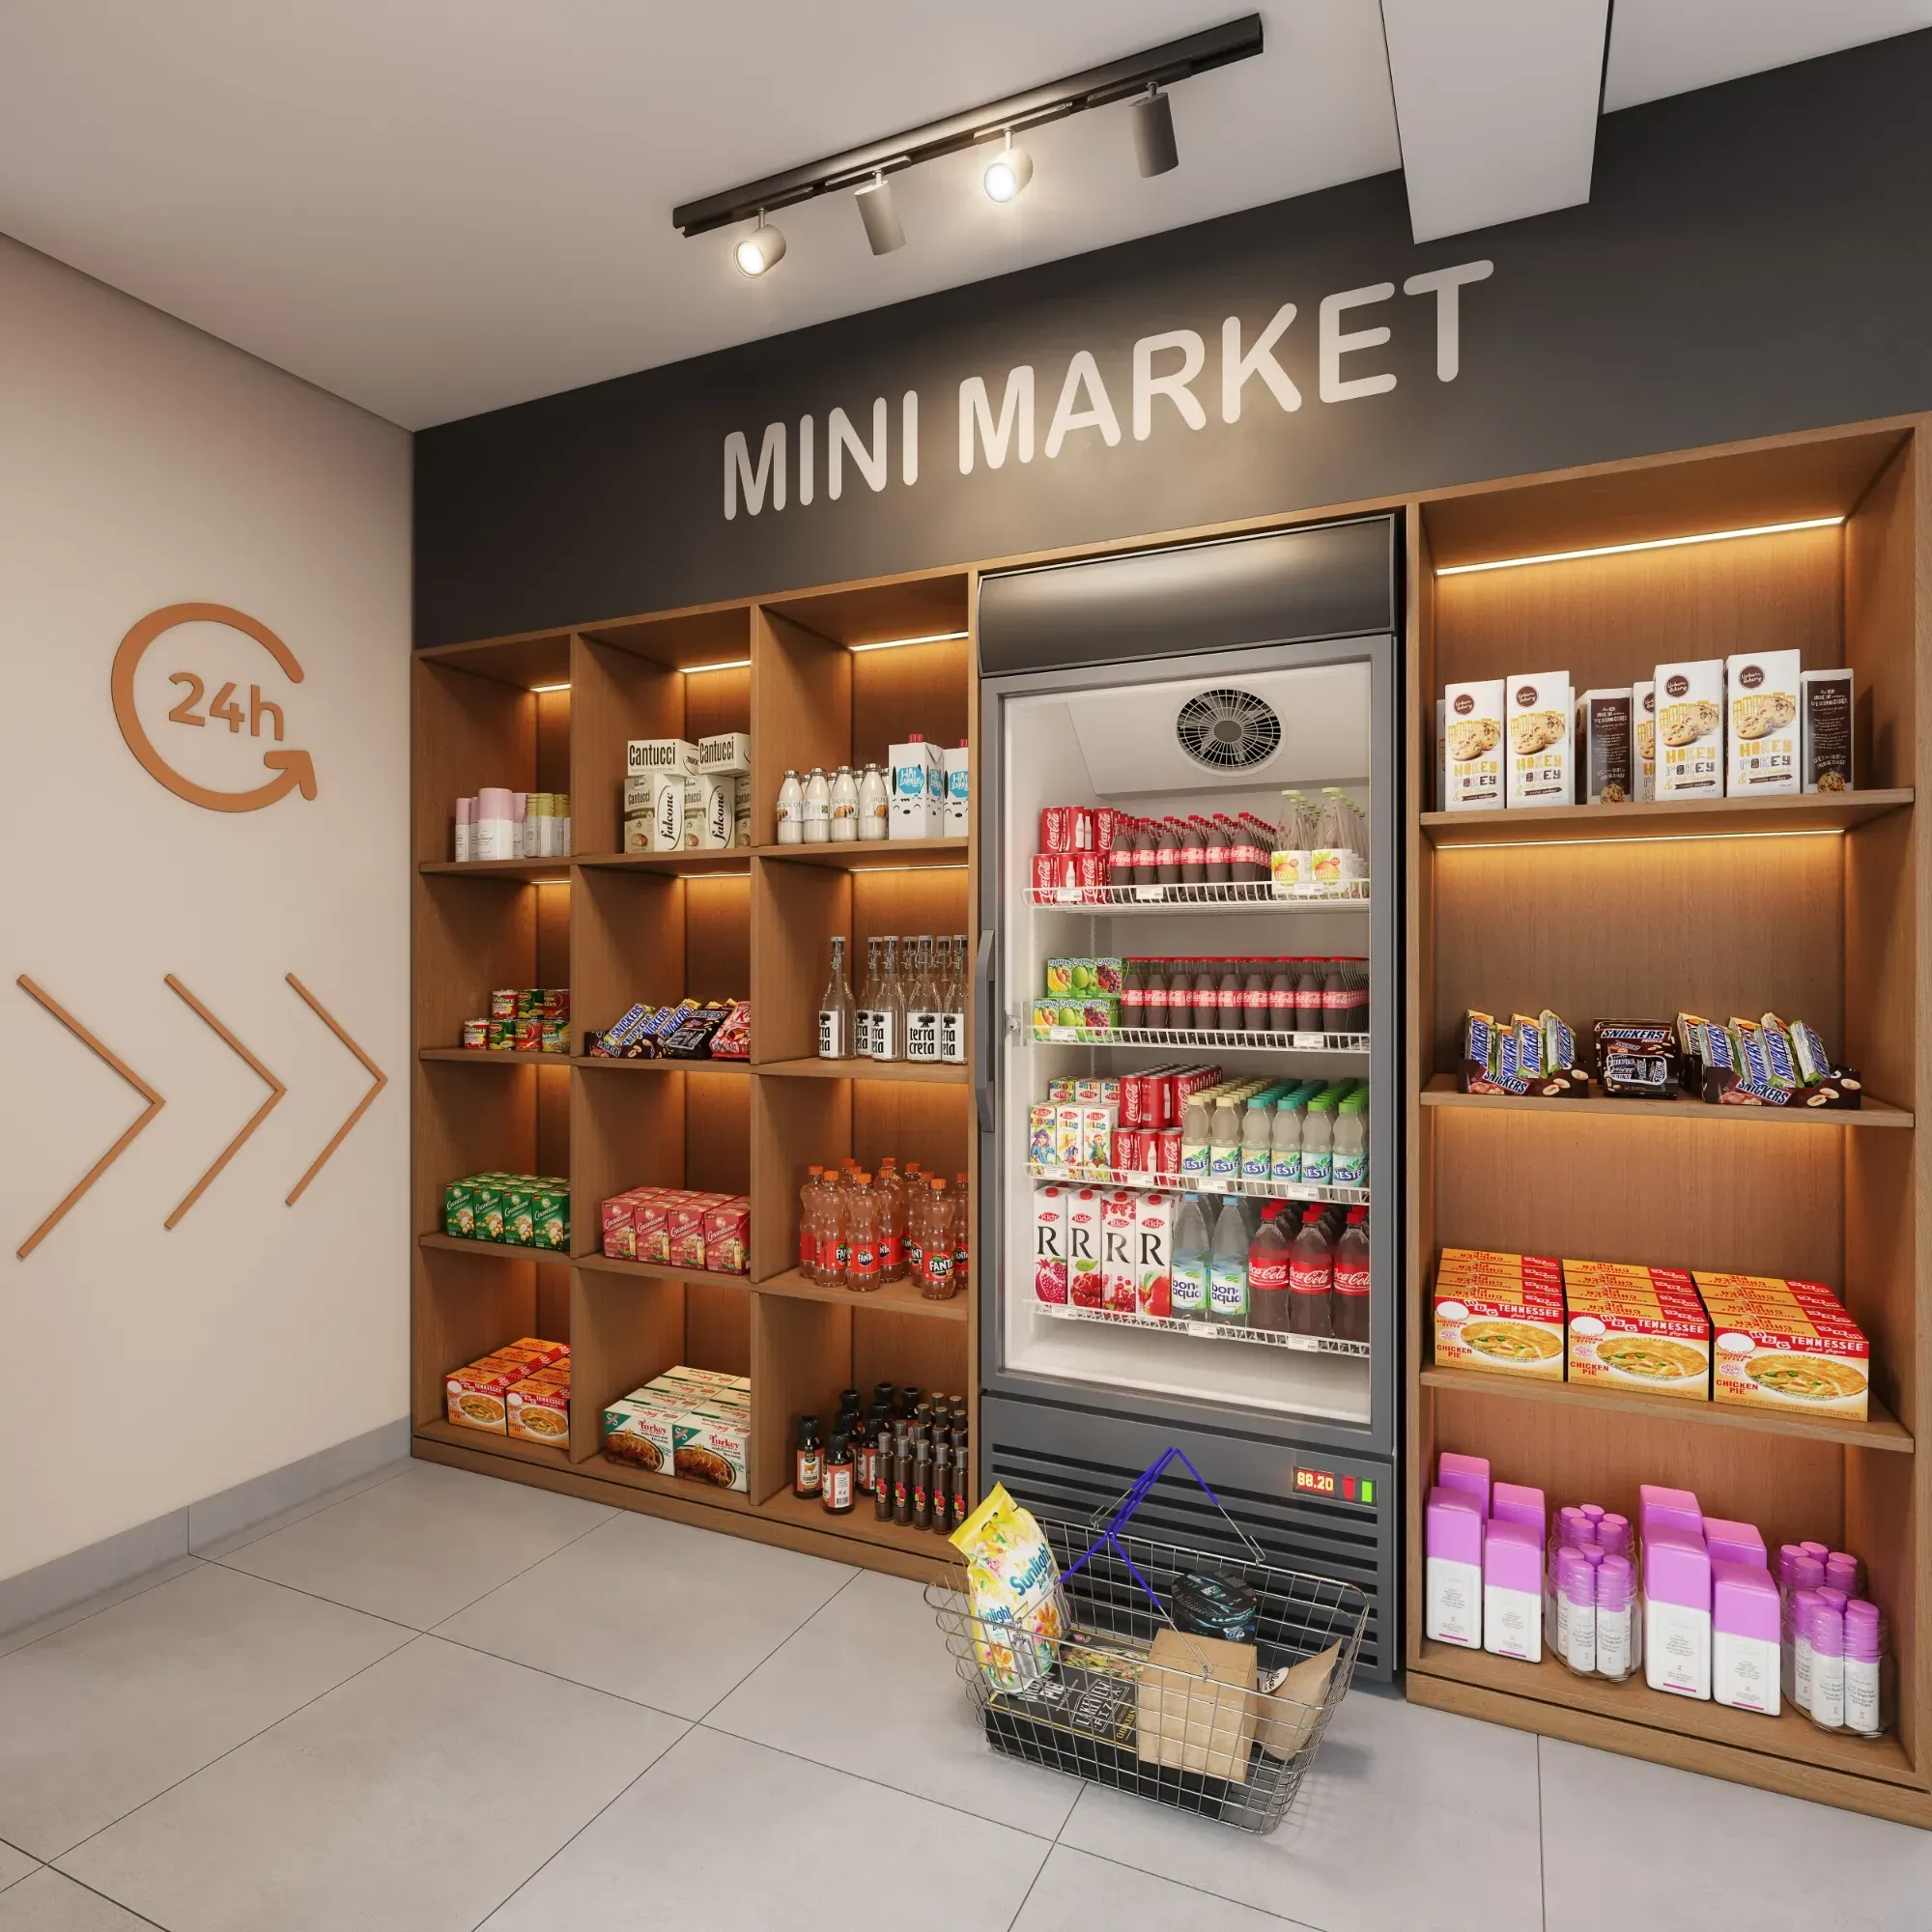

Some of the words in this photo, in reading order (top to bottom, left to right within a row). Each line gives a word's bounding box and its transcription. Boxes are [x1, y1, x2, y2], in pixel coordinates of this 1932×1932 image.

[724, 389, 919, 521] MINI
[959, 259, 1494, 476] MARKET
[168, 671, 285, 742] 24h
[629, 742, 676, 766] Cantucci
[699, 736, 734, 764] Cantucci
[1666, 747, 1716, 764] HOKEY
[1740, 739, 1792, 757] HOKEY
[1454, 760, 1497, 777] HOKEY
[1517, 754, 1562, 771] HOKEY
[628, 790, 650, 805] Cantucci
[685, 790, 702, 804] ntucci
[661, 792, 676, 842] falcone
[712, 792, 726, 842] falcone
[611, 1004, 645, 1039] SNICKERS
[910, 1027, 935, 1041] terra
[1603, 1029, 1664, 1039] SNICKERS
[909, 1041, 935, 1055] creta
[1521, 1022, 1541, 1073] SNICKERS
[1764, 1027, 1796, 1083] SNICKERS
[1484, 1070, 1528, 1094] SNICKERS
[1739, 1080, 1789, 1105] SNICKERS
[1041, 1212, 1057, 1221] Rich
[1074, 1213, 1090, 1223] Rich
[1111, 1219, 1127, 1228] Rich
[1144, 1218, 1161, 1228] Rich
[1037, 1225, 1061, 1257] R
[1071, 1227, 1094, 1260] R
[1106, 1232, 1130, 1264] R
[1140, 1233, 1165, 1266] R
[858, 1253, 873, 1263] FANTA
[929, 1259, 953, 1271] FANTA
[1498, 1303, 1559, 1318] TENNESSEE
[1637, 1320, 1704, 1333] TENNESSEE
[1436, 1344, 1472, 1354] CHICKEN
[1791, 1336, 1863, 1351] TENNESSEE
[1570, 1361, 1609, 1371] CHICKEN
[1716, 1379, 1759, 1390] CHICKEN
[639, 1420, 667, 1435] Turkey
[709, 1435, 740, 1449] Turkey
[1296, 1471, 1334, 1492] 88.20
[1009, 1543, 1052, 1597] Sunlight
[1075, 1681, 1112, 1725] LAKEVIEW
